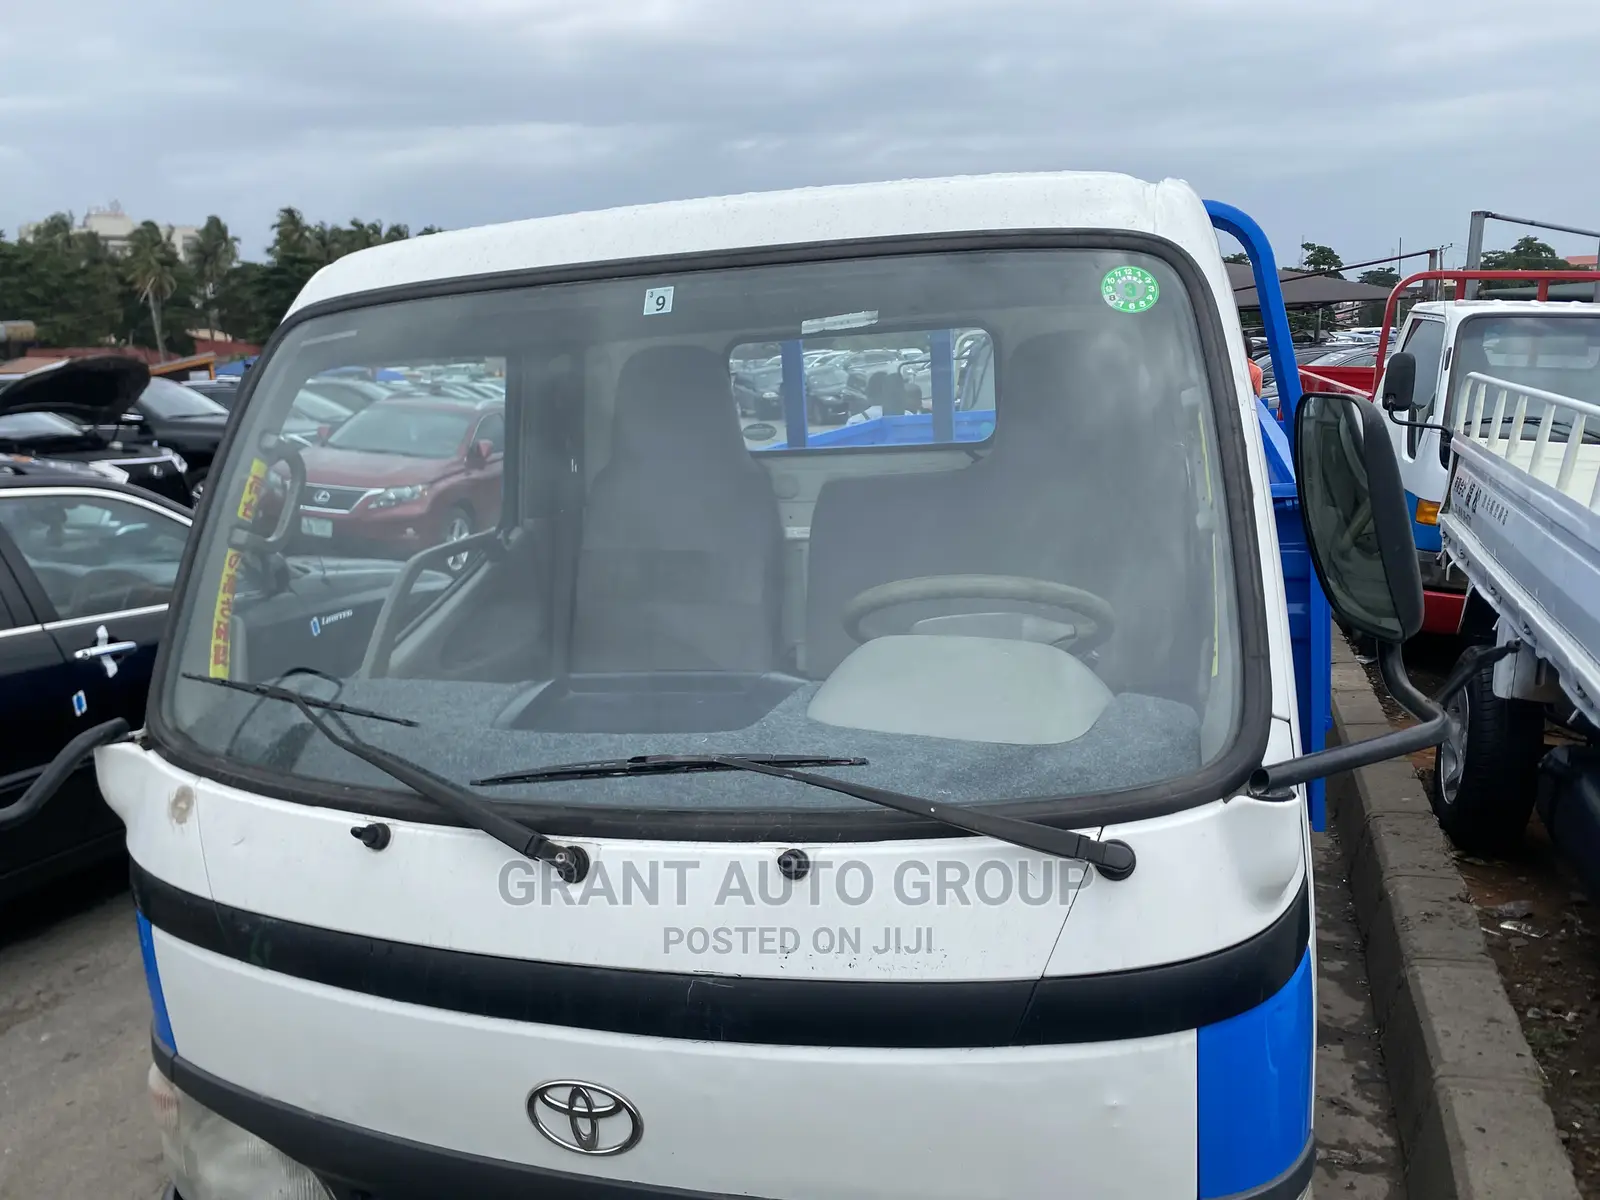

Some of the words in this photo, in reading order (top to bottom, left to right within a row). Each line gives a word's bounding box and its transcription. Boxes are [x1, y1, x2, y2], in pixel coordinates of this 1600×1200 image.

[1144, 276, 1152, 284] 2
[1109, 294, 1116, 302] 8
[656, 295, 666, 312] 9
[1129, 302, 1135, 310] 6
